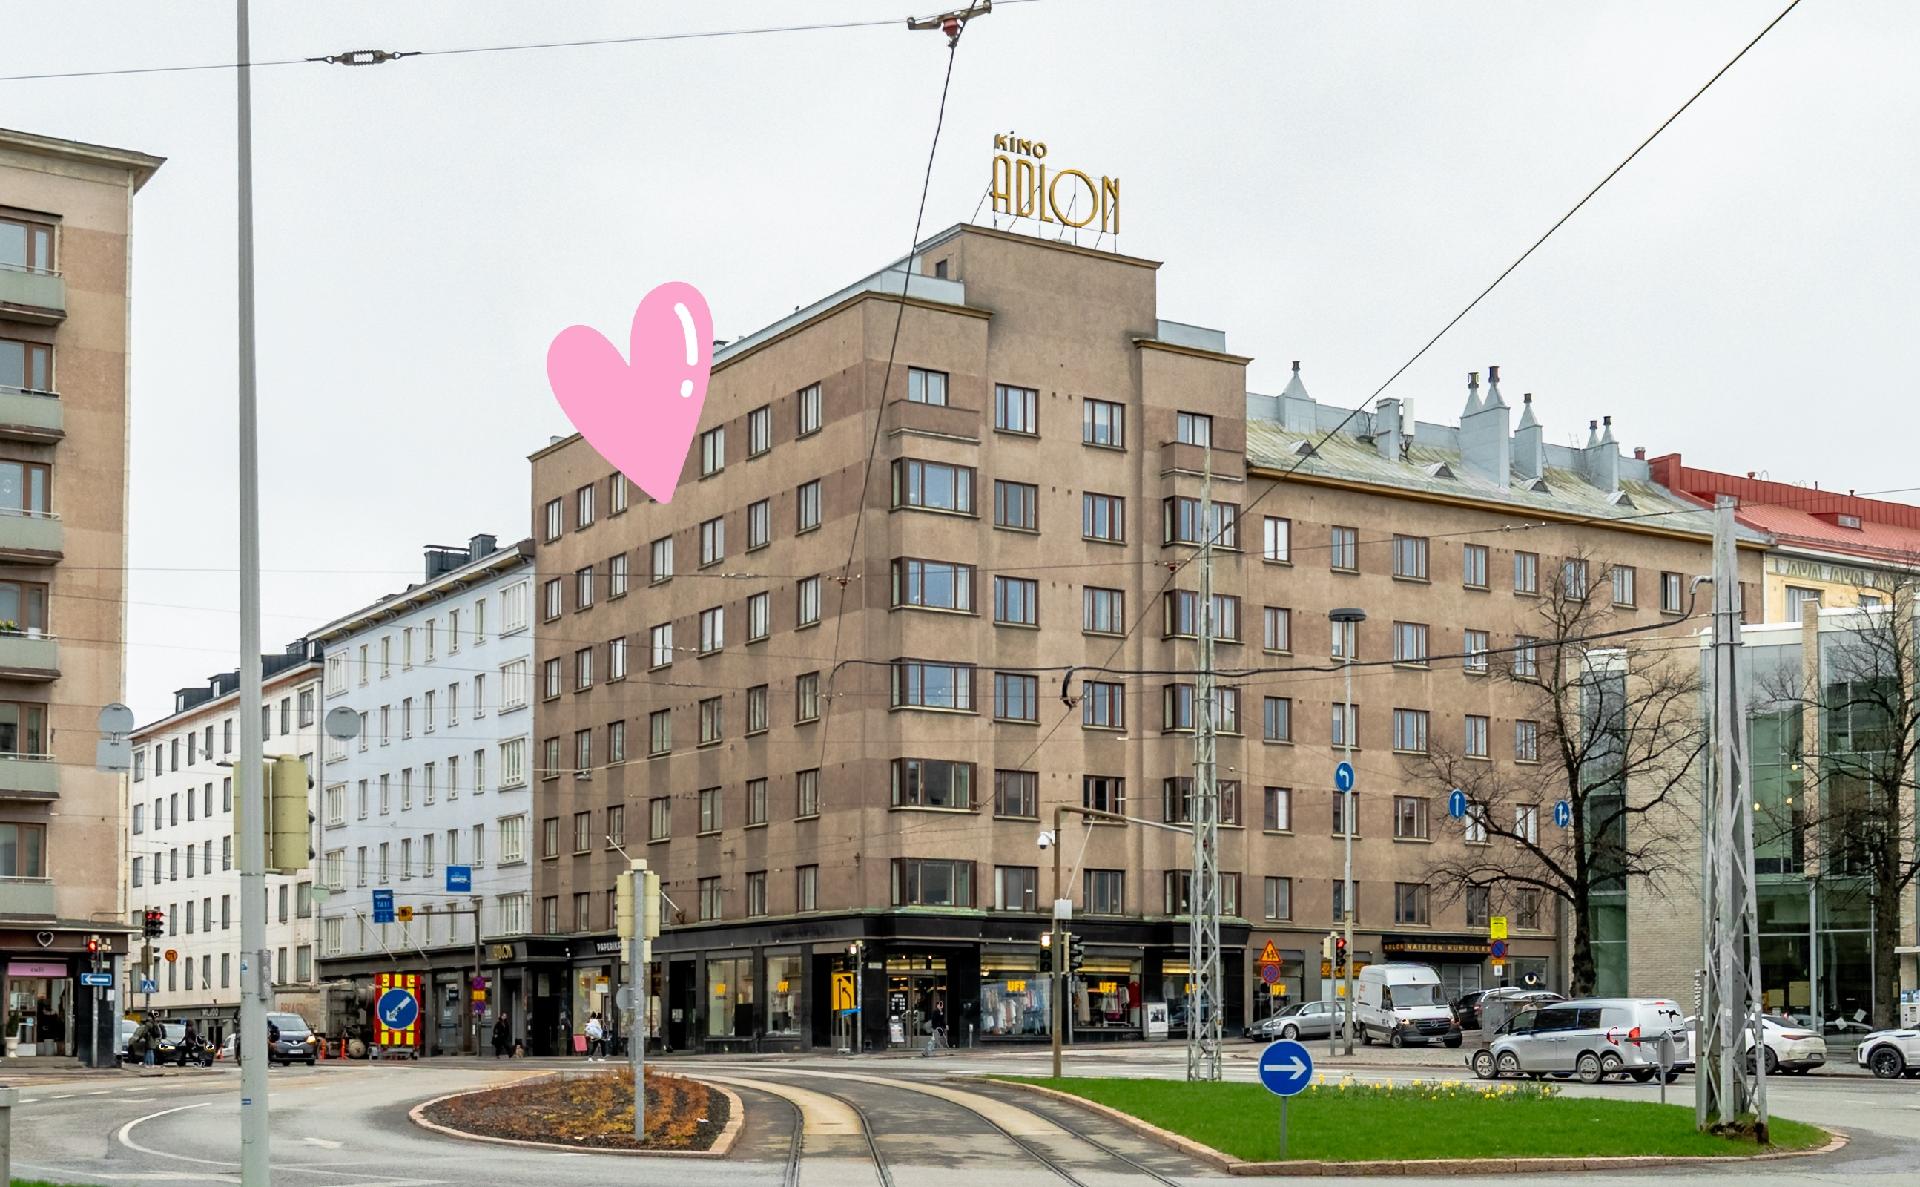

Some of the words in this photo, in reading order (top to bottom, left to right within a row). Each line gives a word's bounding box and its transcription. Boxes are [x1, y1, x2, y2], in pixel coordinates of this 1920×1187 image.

[989, 155, 1120, 234] ADLON
[1007, 980, 1026, 992] UFF
[1098, 982, 1118, 993] UFF
